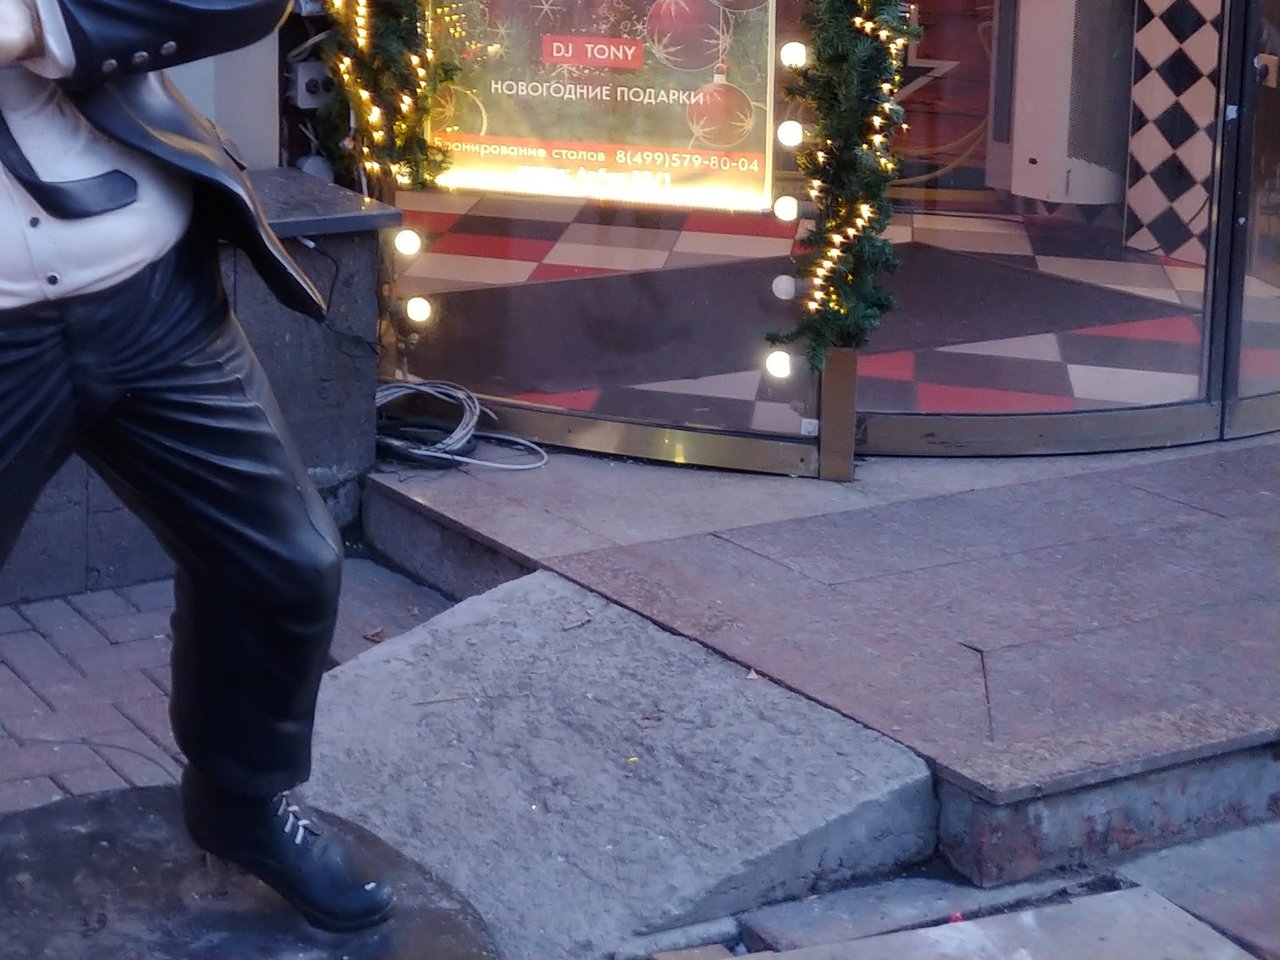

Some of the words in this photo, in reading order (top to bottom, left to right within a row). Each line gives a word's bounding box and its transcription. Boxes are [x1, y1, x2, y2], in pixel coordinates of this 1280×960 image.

[552, 42, 573, 58] DJ
[585, 43, 637, 61] TONY
[491, 80, 612, 101] НОВОГОДНИЕ
[616, 86, 704, 106] ПОДАРКИ
[552, 148, 606, 162] столов
[615, 150, 759, 172] 8(499)579-80-04
